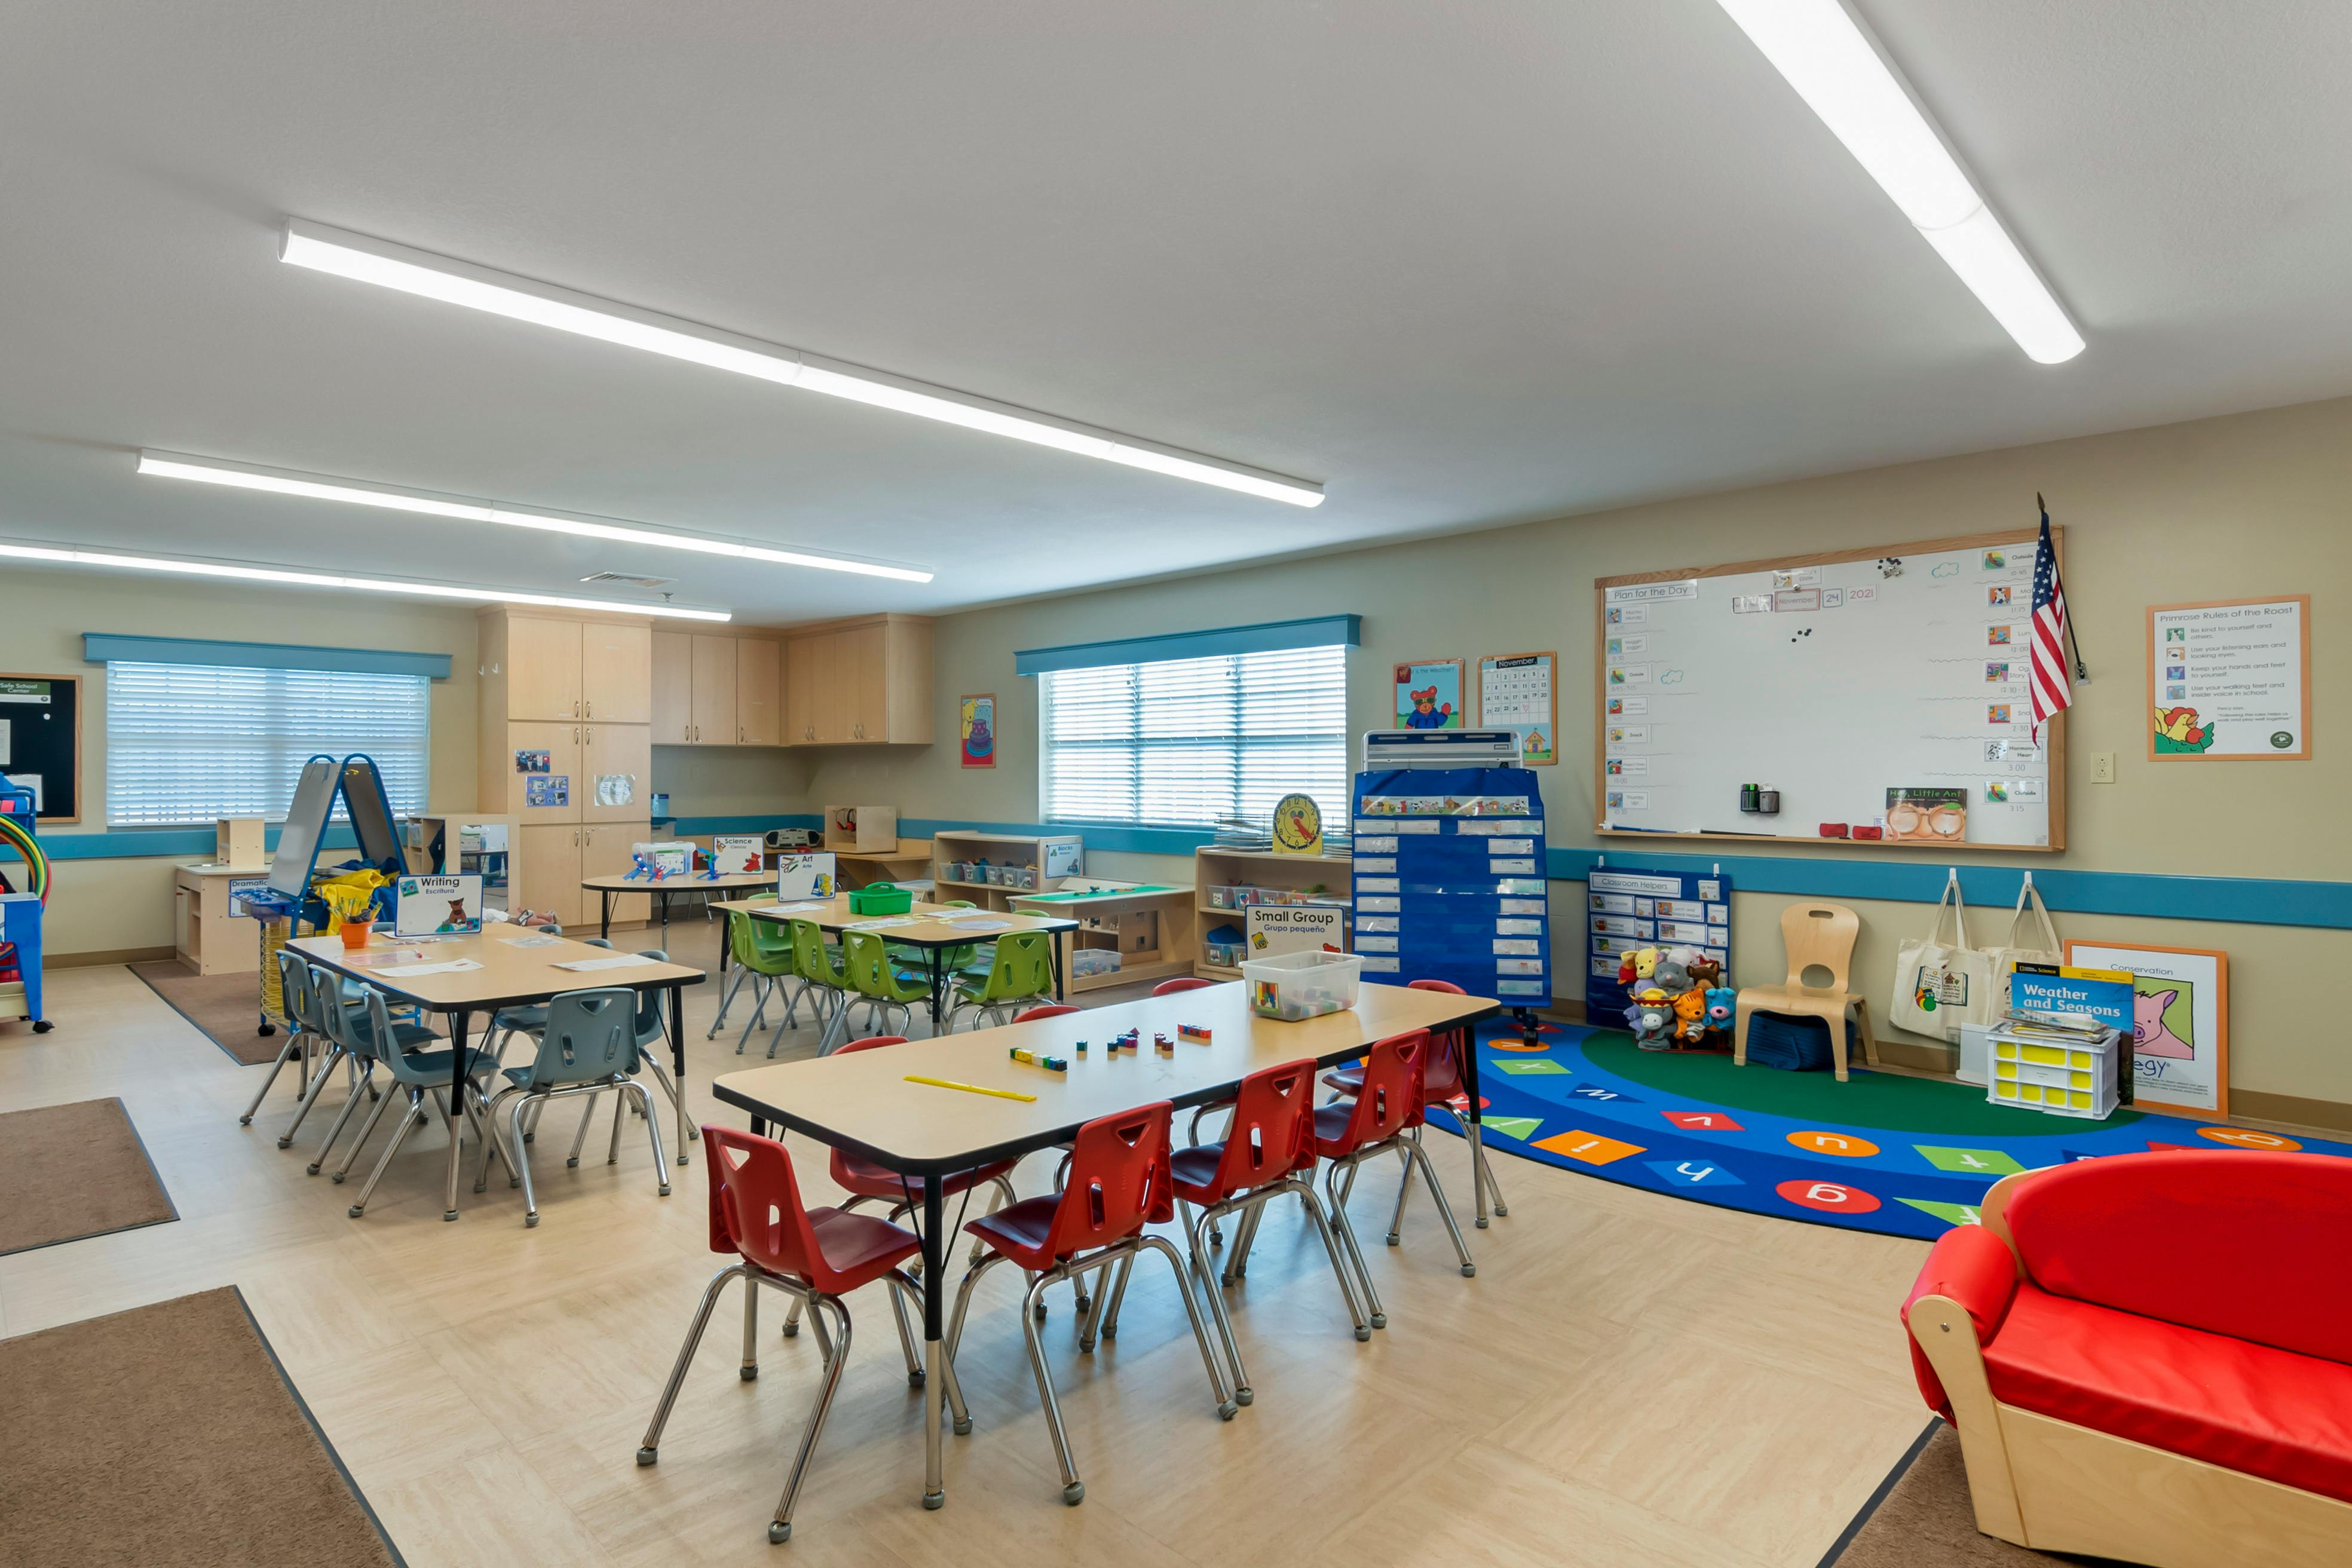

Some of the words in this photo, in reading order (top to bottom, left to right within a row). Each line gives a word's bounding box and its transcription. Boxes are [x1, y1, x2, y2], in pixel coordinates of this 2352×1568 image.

[1615, 592, 1633, 600] Plan
[1668, 586, 1688, 595] Day
[1826, 593, 1839, 602] 24
[1849, 589, 1873, 599] 2021
[2160, 614, 2200, 622] Primrose
[2264, 607, 2293, 615] Roost
[1889, 790, 1910, 798] Hy,
[421, 877, 460, 888] Writing
[1601, 878, 1639, 887] Classroom
[1640, 881, 1668, 890] Helpers
[1255, 911, 1289, 922] Small
[1293, 912, 1334, 925] Group
[1264, 924, 1288, 933] Grupo
[1290, 925, 1325, 933] pequeño
[2111, 963, 2173, 975] Conservation
[2023, 984, 2088, 1001] Weather
[2023, 998, 2051, 1009] and
[2057, 1000, 2121, 1017] Seasons
